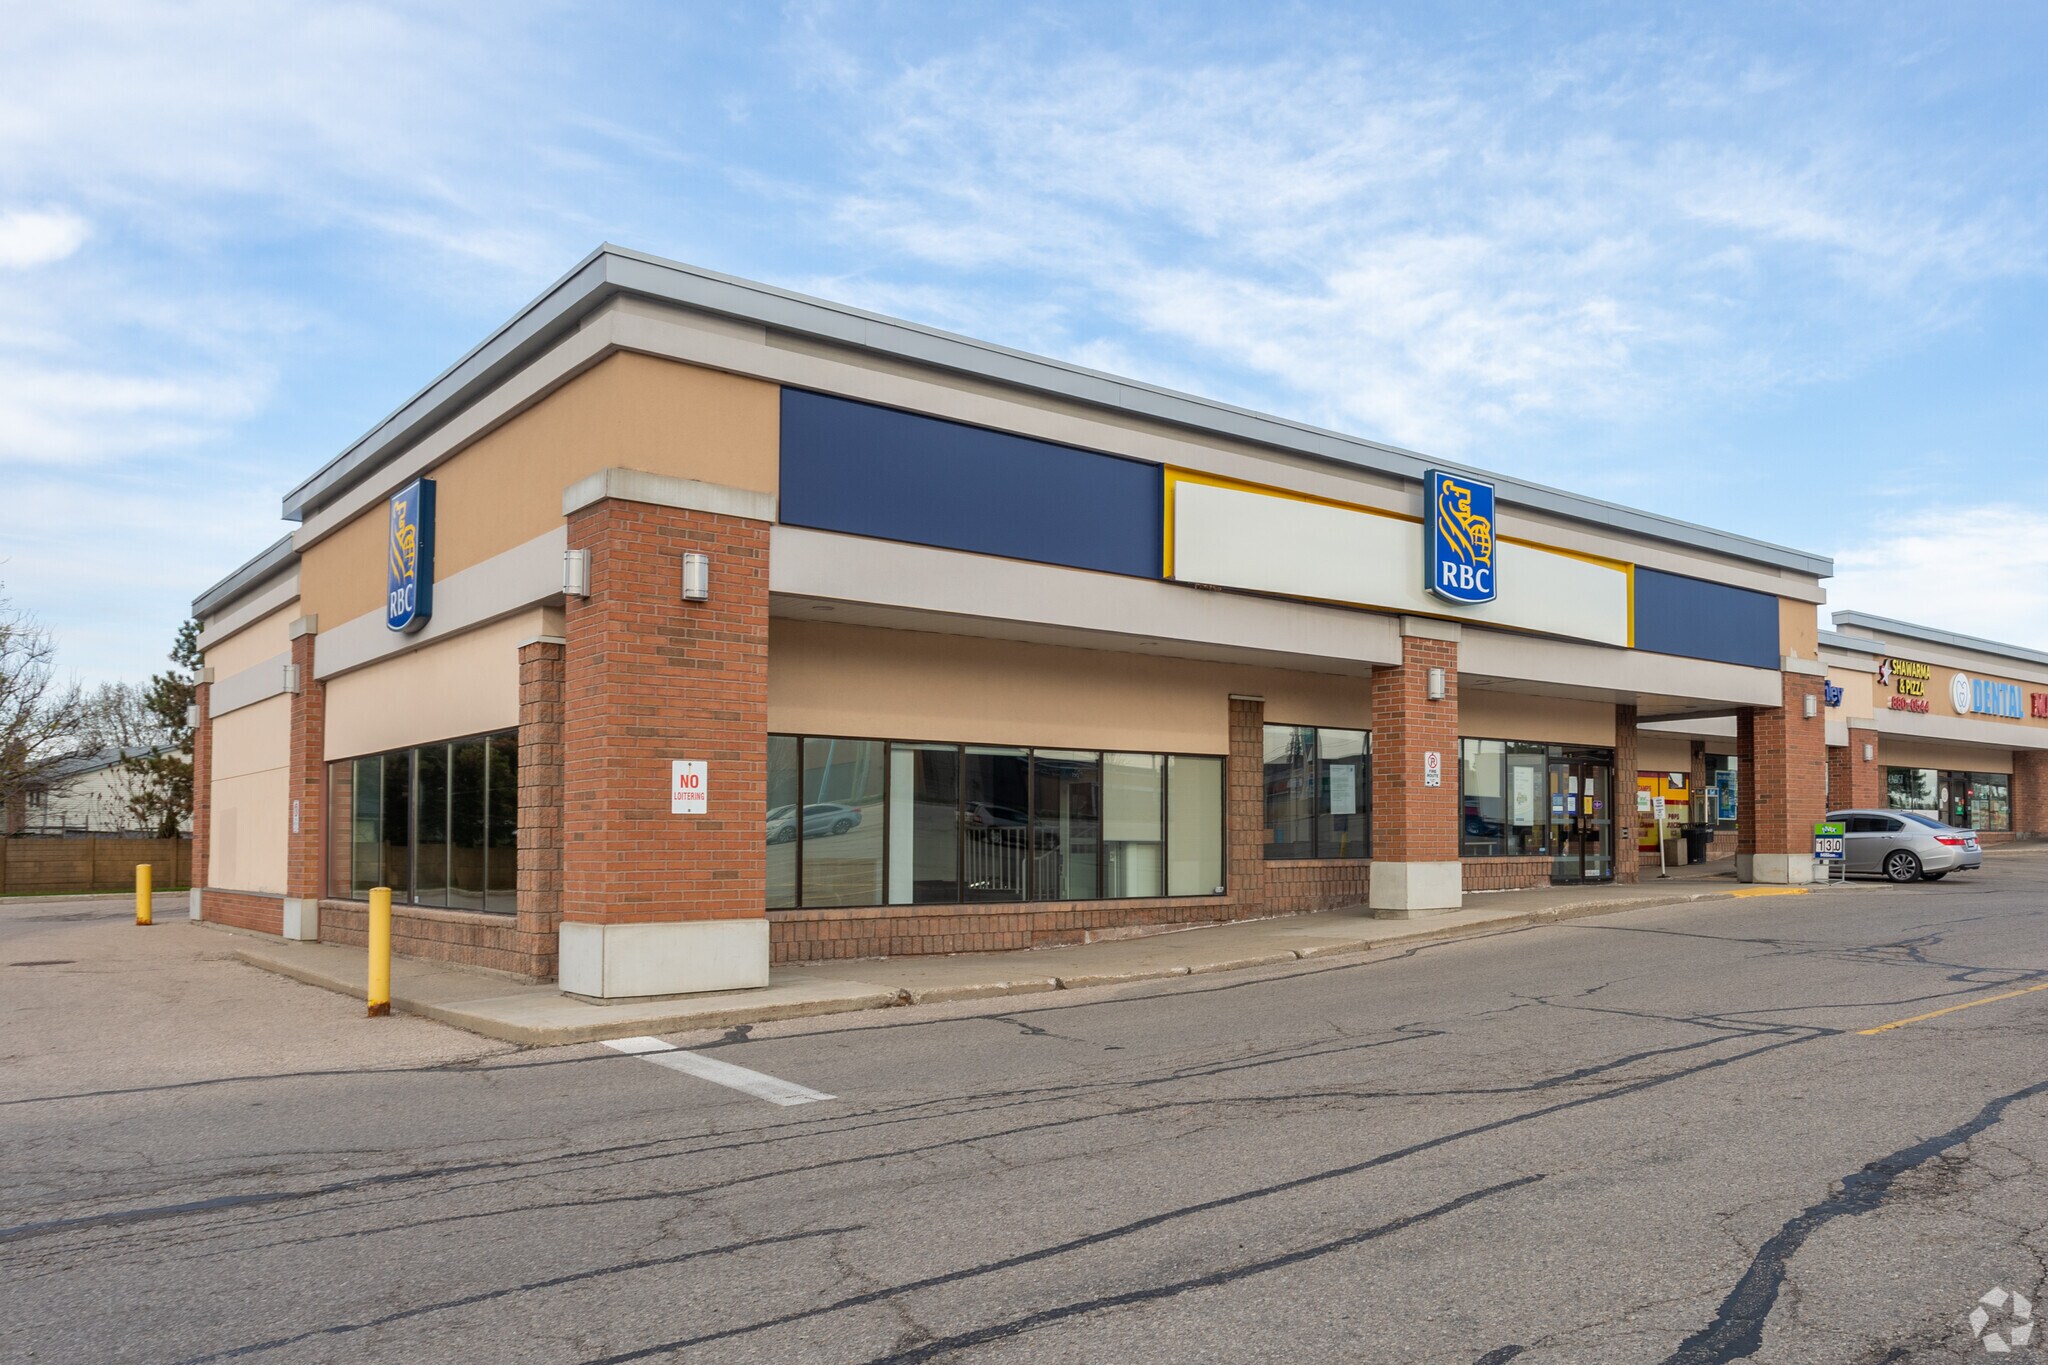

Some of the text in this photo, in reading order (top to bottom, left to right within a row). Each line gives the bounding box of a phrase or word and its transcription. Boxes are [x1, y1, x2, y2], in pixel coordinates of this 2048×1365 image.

[1442, 561, 1490, 593] RBC
[390, 584, 413, 619] RBC
[1892, 659, 1931, 680] SHAWARMA
[1906, 680, 1925, 696] PIZZA
[1972, 678, 2025, 718] DENTAL
[680, 774, 699, 788] NO
[674, 792, 705, 800] LOITERING
